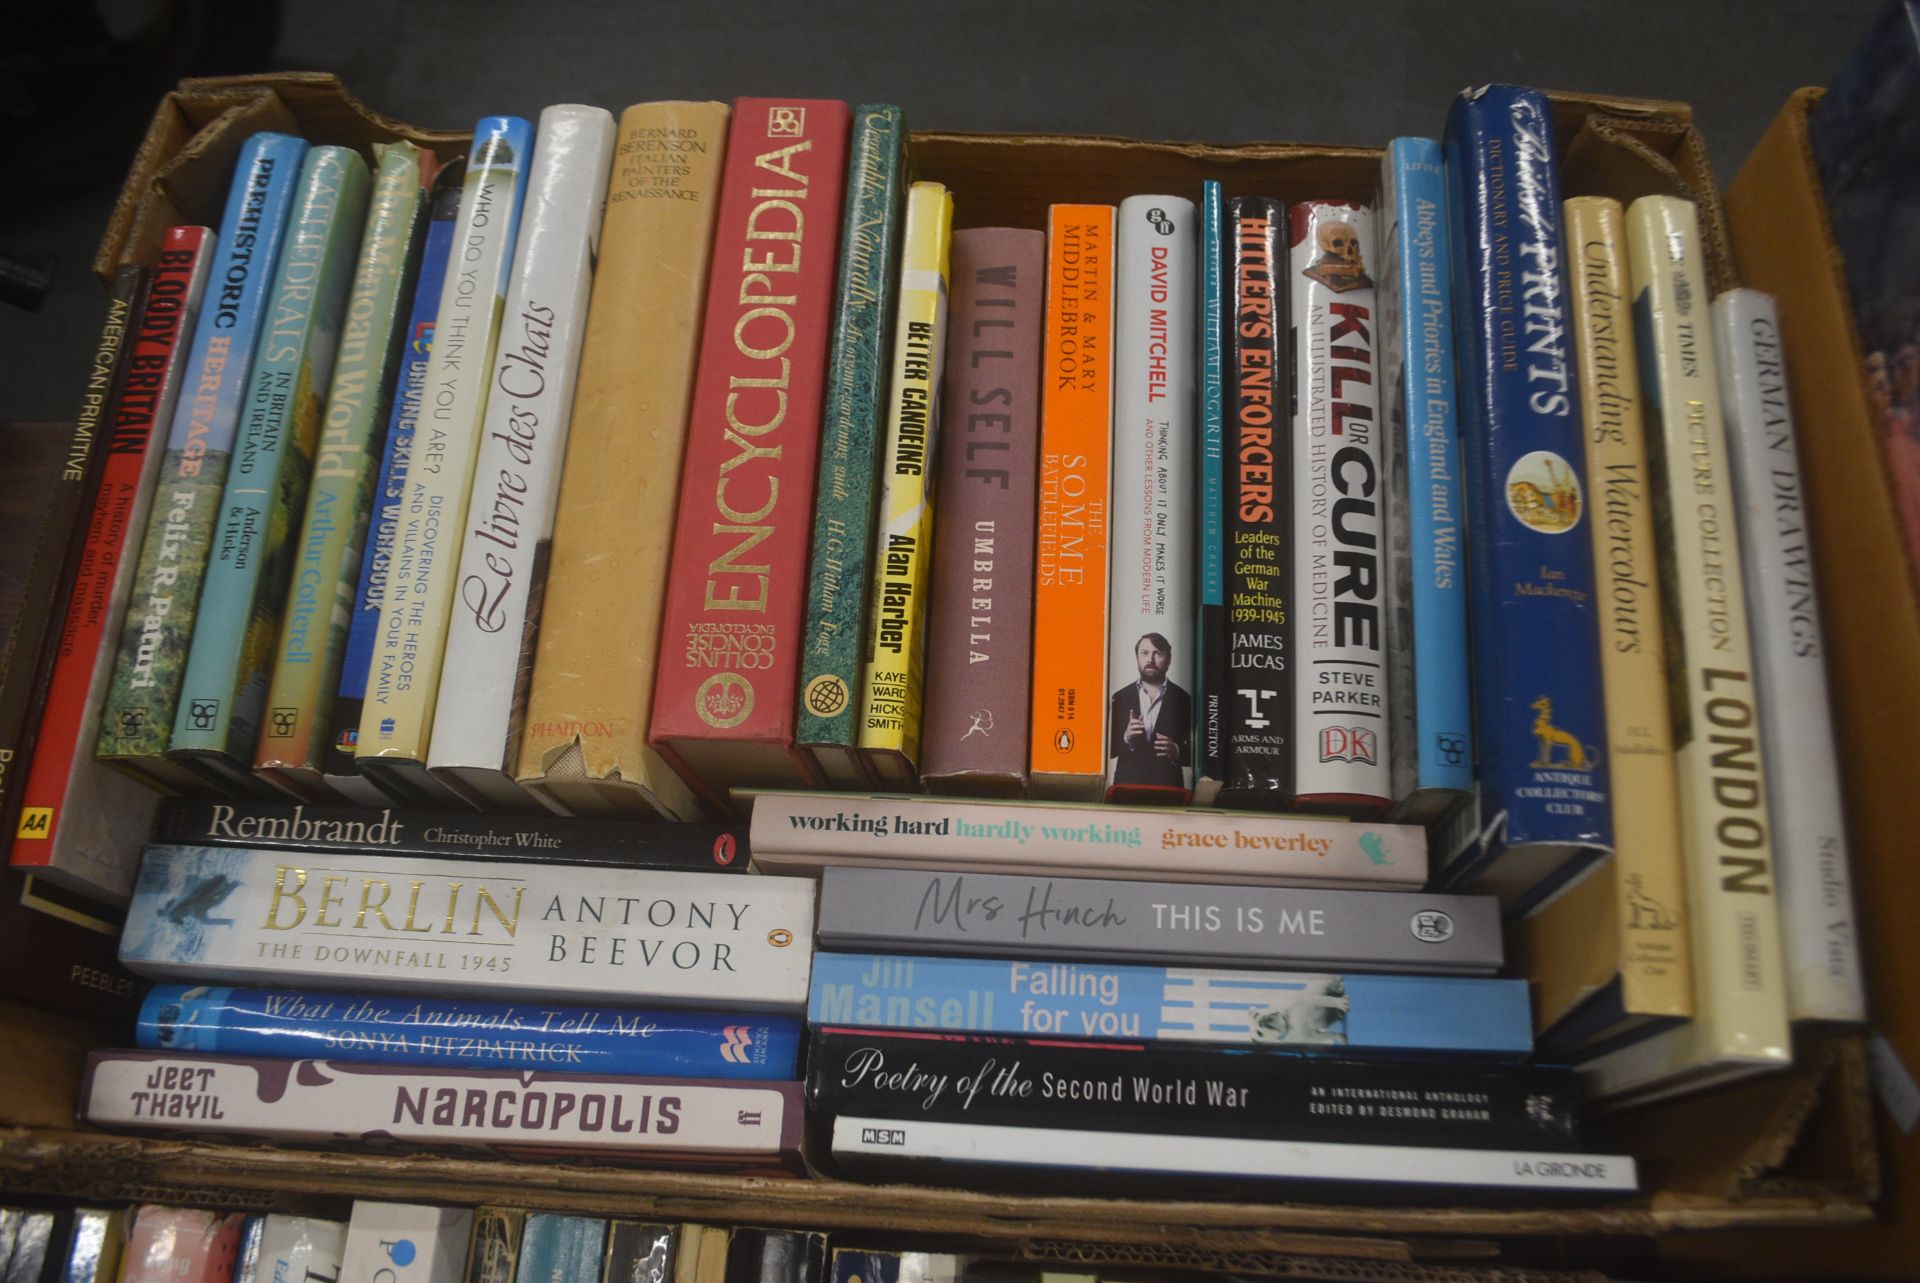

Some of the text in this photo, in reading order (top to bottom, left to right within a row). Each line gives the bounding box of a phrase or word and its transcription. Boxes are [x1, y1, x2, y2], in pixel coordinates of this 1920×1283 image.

[620, 140, 706, 155] BERENSON
[630, 128, 697, 139] BERNARD
[214, 158, 275, 329] PREHISTORIC
[1414, 198, 1436, 257] Abbeys
[262, 159, 347, 452] CATHEDRALS IN BRITAIN
[339, 236, 397, 361] Minoan
[1058, 224, 1080, 390] MIDDLEBROOK
[1082, 224, 1099, 392] MARTIN & MARY
[1420, 260, 1440, 294] and
[110, 251, 193, 454] BLOODY BRITAIN
[423, 184, 495, 474] WHO DO YOU THINK YOU ARE?
[498, 300, 555, 399] Chats
[1148, 247, 1168, 403] DAVID MITCHELL
[1206, 299, 1221, 371] WILLIAM
[1422, 300, 1444, 372] Priories
[1519, 243, 1570, 417] PRINTS
[1678, 324, 1699, 378] TIMES
[62, 299, 128, 481] AMERICAN PRIMITIVE
[704, 140, 812, 613] ENCYCLOPEDIA
[895, 322, 933, 477] BETTER CANOEING
[966, 266, 1017, 490] WILL SELF
[1239, 217, 1273, 523] HITLER'S ENFORCERS
[1427, 378, 1447, 394] in
[178, 336, 233, 478] HERITAGE
[240, 372, 273, 474] AND IRELAND
[316, 372, 369, 477] World
[492, 405, 540, 465] des
[1206, 376, 1221, 458] HOGARTH
[1423, 398, 1452, 480] England
[1584, 240, 1648, 654] Understanding Watercolours
[1311, 304, 1328, 649] AN ILLUSTRATED HISTORY OF MEDICINE
[1329, 302, 1379, 651] KILL OR CURE
[1432, 484, 1453, 521] and
[1752, 318, 1817, 658] GERMAN DRAWINGS
[155, 491, 196, 565] Felix
[235, 507, 261, 569] Anderson
[305, 491, 337, 563] Arthur
[474, 470, 528, 550] livre
[1040, 454, 1059, 586] BATTLEFIELDS
[1058, 454, 1087, 585] SOMME
[1089, 498, 1103, 535] THE
[1235, 531, 1280, 546] Leaders
[1686, 401, 1732, 652] PICTURE COLLECTION
[1234, 562, 1280, 576] German
[1240, 547, 1275, 560] of the
[1246, 577, 1269, 591] War
[1434, 526, 1456, 589] Wales
[285, 568, 322, 664] Cotterell
[376, 483, 426, 704] AND VILLAINS IN YOUR FAMILY
[397, 495, 443, 691] DISCOVERING THE HEROES
[880, 533, 916, 654] Alan Harber
[969, 521, 994, 664] UMBRELLA
[1231, 608, 1285, 624] 1939-1945
[1232, 593, 1282, 608] Machine
[686, 634, 776, 652] CONCISE
[686, 651, 775, 669] COLLINS
[689, 624, 775, 634] ENCYCLOPEDIA
[1231, 632, 1283, 650] JAMES
[873, 686, 906, 699] WARD
[874, 671, 907, 684] KAYE
[1231, 654, 1285, 670] LUCAS
[1319, 672, 1374, 687] STEVE
[870, 704, 904, 716] HICKS
[1208, 695, 1218, 758] PRINCETON
[1313, 691, 1380, 707] PARKER
[1324, 728, 1371, 759] DK
[1701, 668, 1771, 896] LONDON
[22, 815, 48, 831] AA
[207, 805, 404, 845] Rembrandt
[423, 828, 561, 849] Christopher White
[789, 813, 1333, 857] working hard hardly working grace beverley
[261, 864, 527, 938] BERLIN
[541, 895, 750, 931] ANTONY
[914, 876, 1325, 938] Mrs Hinch THIS IS ME
[71, 964, 136, 996] PEEBLES
[257, 942, 512, 973] THE DOWNFALL 1945
[548, 934, 736, 971] BEEVOR
[862, 958, 915, 989] Jill
[1010, 962, 1119, 1005] Falling
[264, 995, 656, 1038] What the Animals Tell Me
[820, 983, 994, 1030] Mansell
[1021, 1001, 1140, 1037] for you
[325, 1029, 585, 1063] SONYA FITZPATRICK
[841, 1047, 1248, 1109] Poetry of the Second World War
[862, 1128, 905, 1145] MSM
[1514, 1161, 1606, 1178] LA GIRONDE
